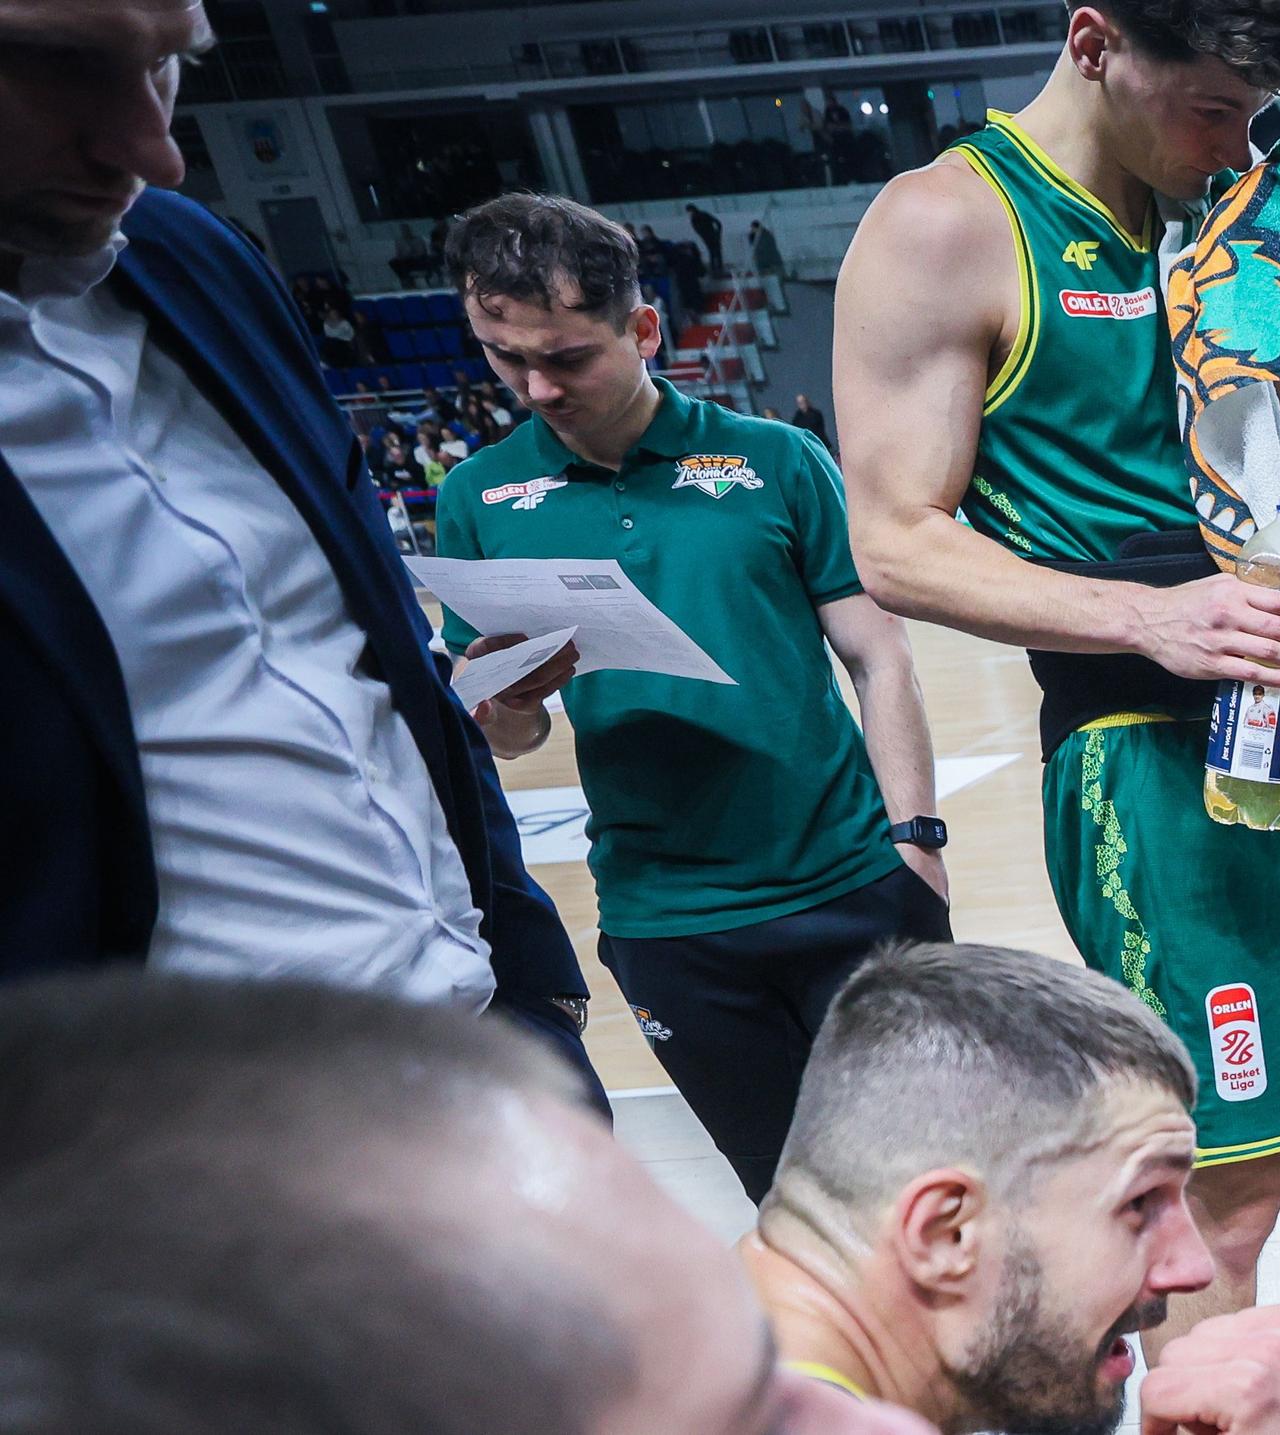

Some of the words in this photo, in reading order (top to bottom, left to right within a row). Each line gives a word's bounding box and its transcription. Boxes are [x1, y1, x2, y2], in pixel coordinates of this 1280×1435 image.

[1062, 240, 1100, 270] 4F
[1123, 291, 1153, 305] Basket
[1125, 305, 1145, 316] Liga
[487, 485, 525, 501] ORLEN
[511, 490, 548, 511] 4F
[1212, 999, 1252, 1015] ORLEN
[1221, 1067, 1261, 1082] Basket
[1230, 1079, 1255, 1092] Liga
